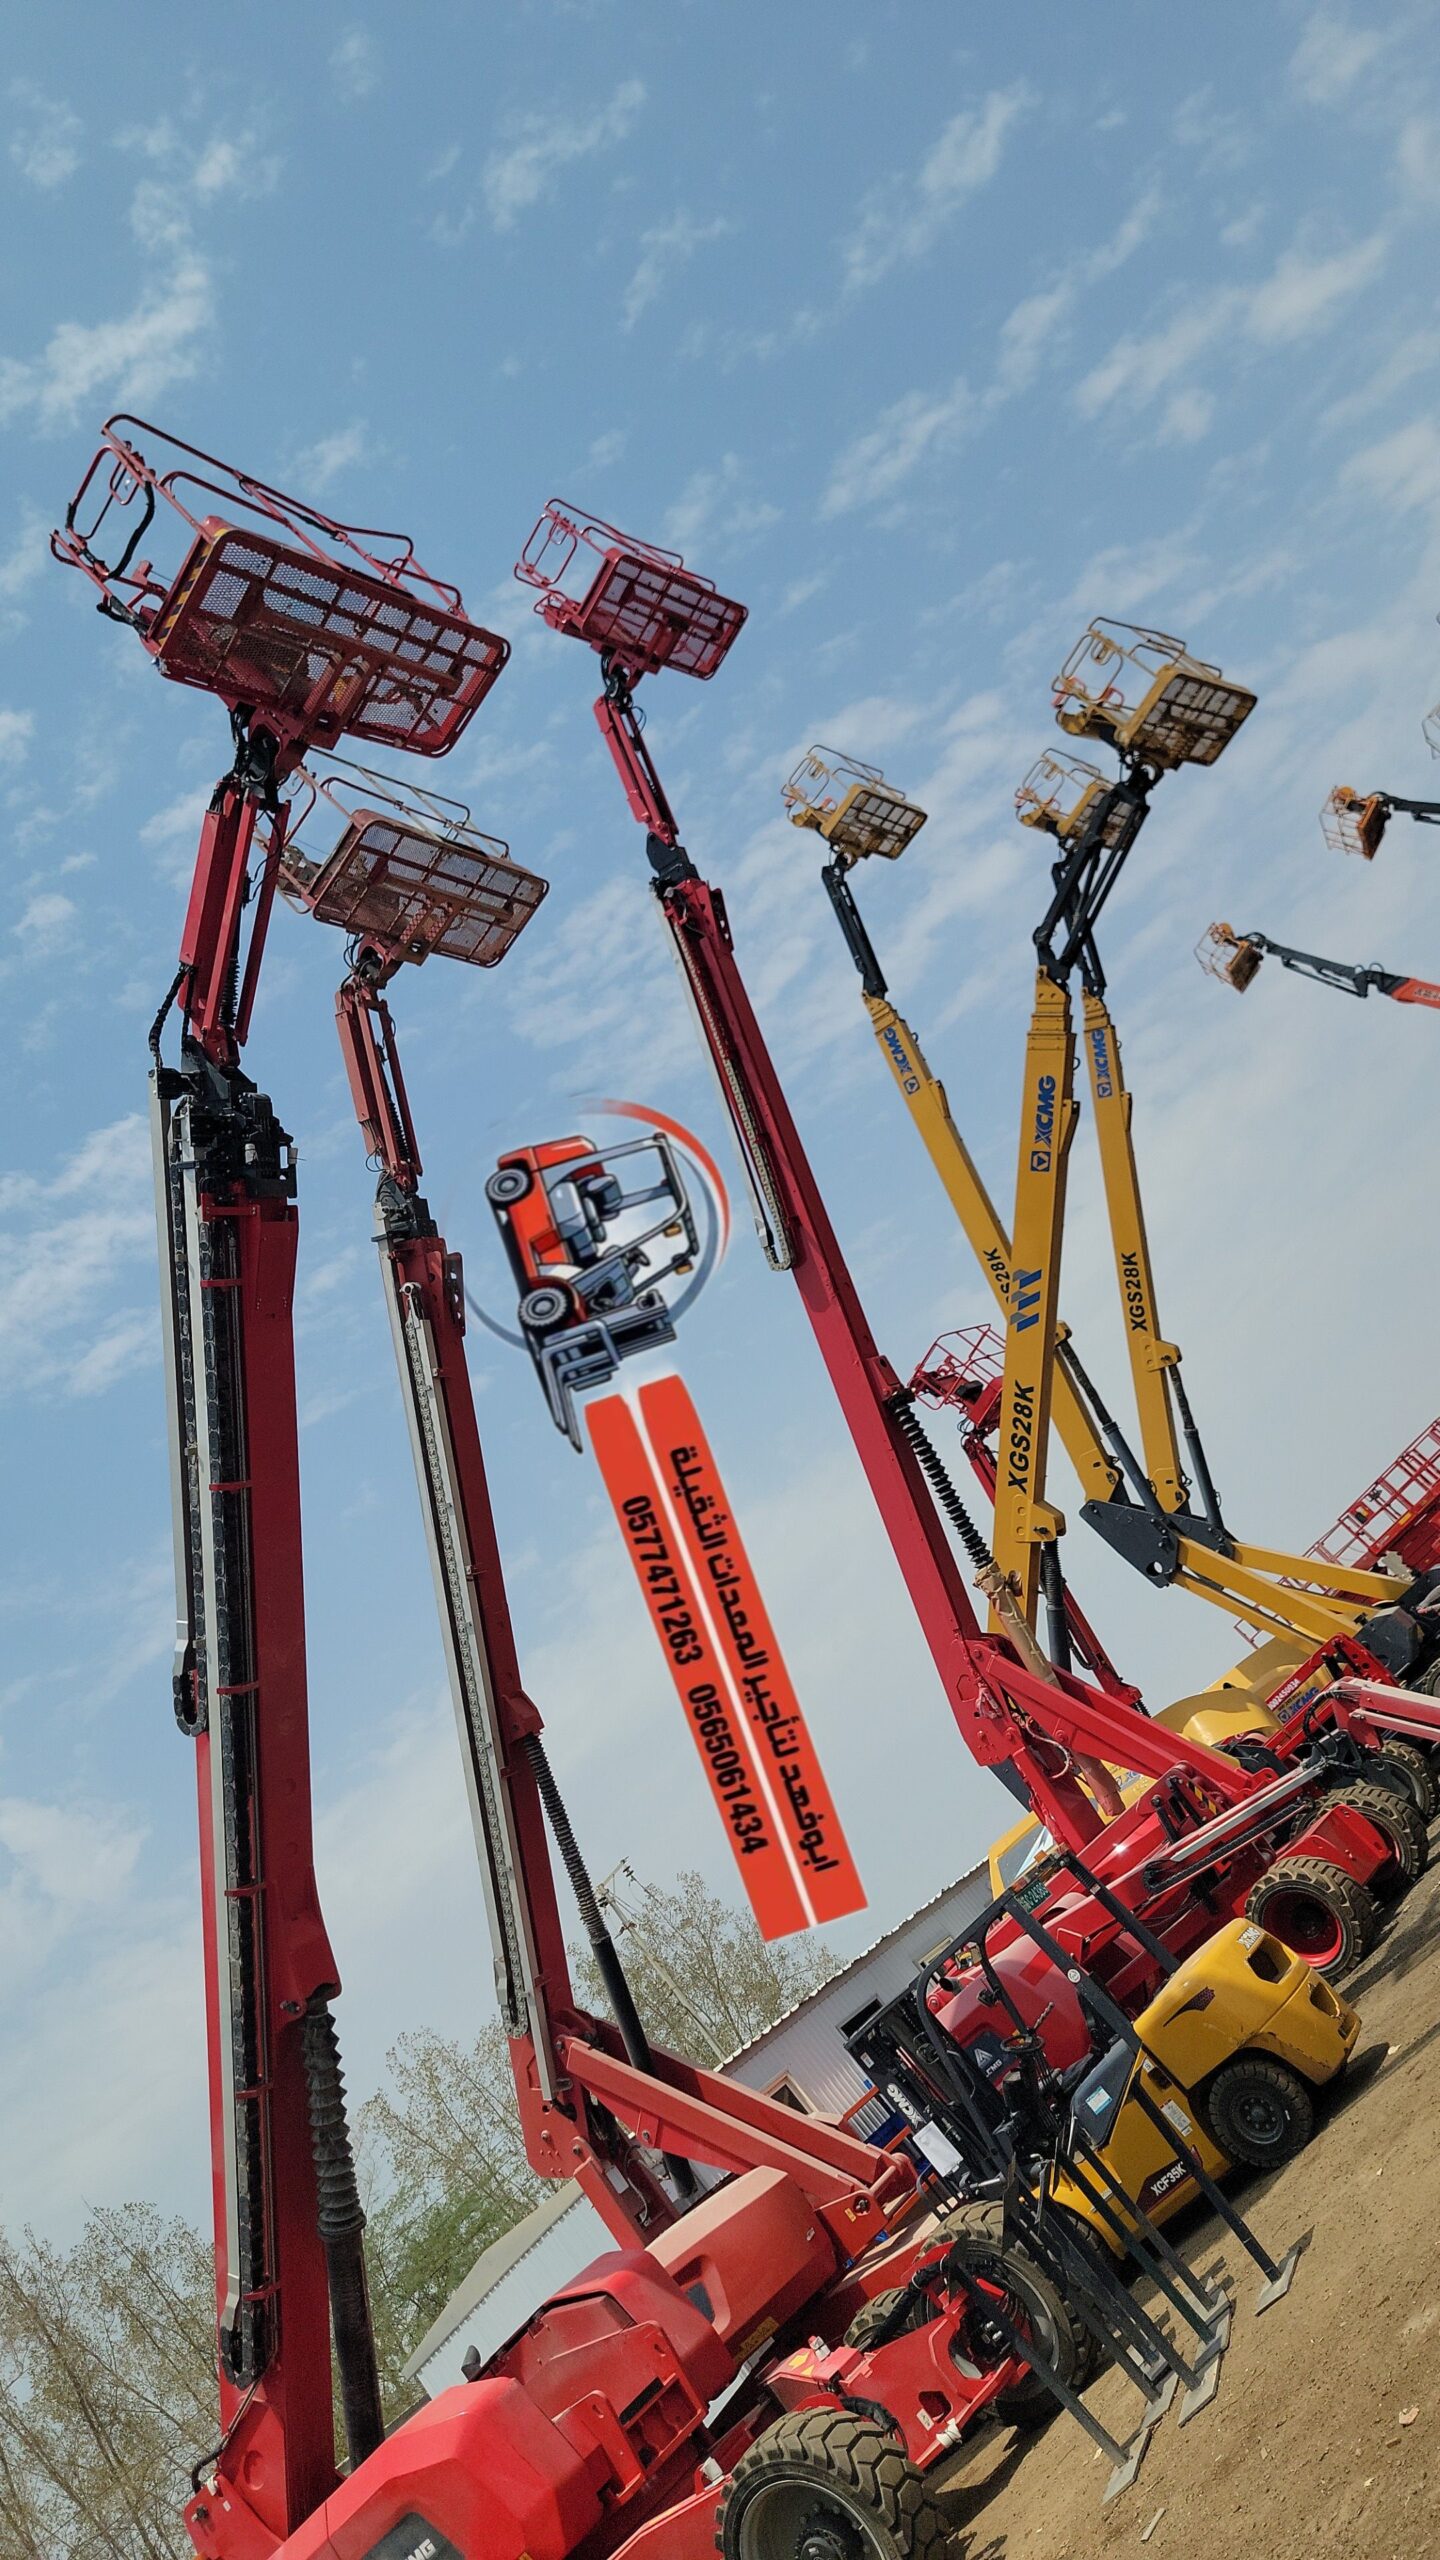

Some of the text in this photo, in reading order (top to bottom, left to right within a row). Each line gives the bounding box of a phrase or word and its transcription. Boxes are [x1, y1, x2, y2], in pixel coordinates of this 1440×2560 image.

[884, 1027, 913, 1075] XCMG
[1091, 1029, 1110, 1080] XCMG
[1034, 1075, 1056, 1149] XCMG
[1121, 1252, 1148, 1332] XGS28K
[1008, 1379, 1035, 1494] XGS28K
[886, 2082, 928, 2129] XCMG
